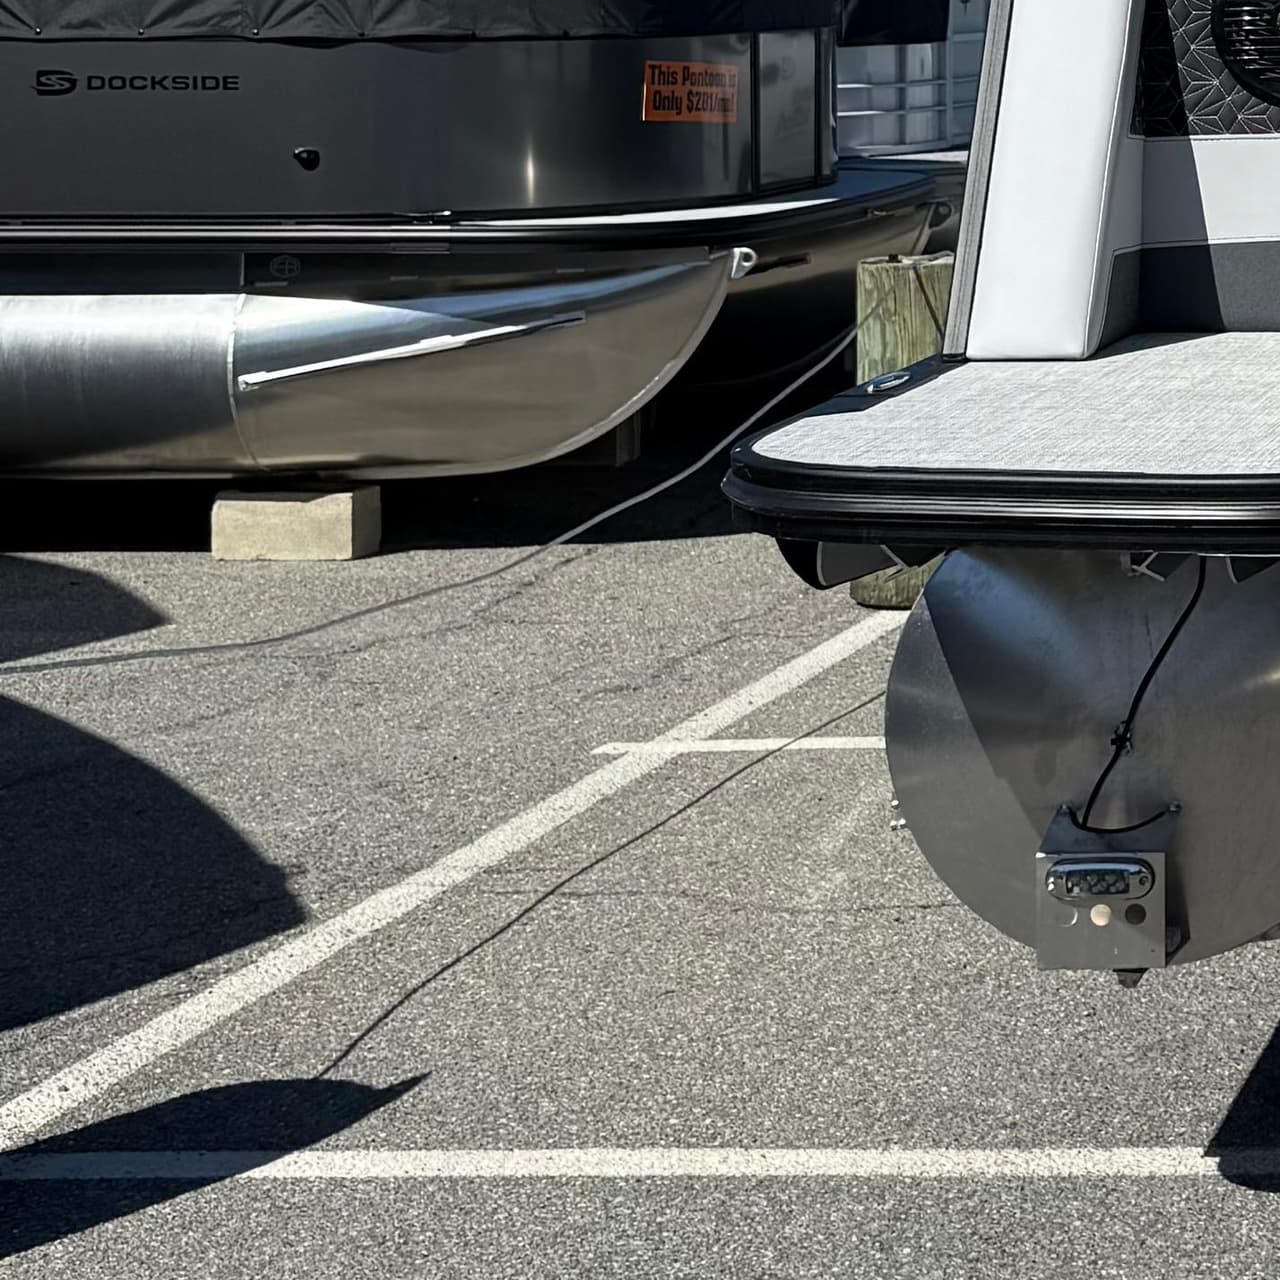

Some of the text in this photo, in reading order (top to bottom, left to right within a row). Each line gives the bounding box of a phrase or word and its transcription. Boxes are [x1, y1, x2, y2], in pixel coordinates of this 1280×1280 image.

[87, 75, 240, 91] DOCKSIDE
[648, 64, 678, 86] This
[653, 90, 682, 116] Only
